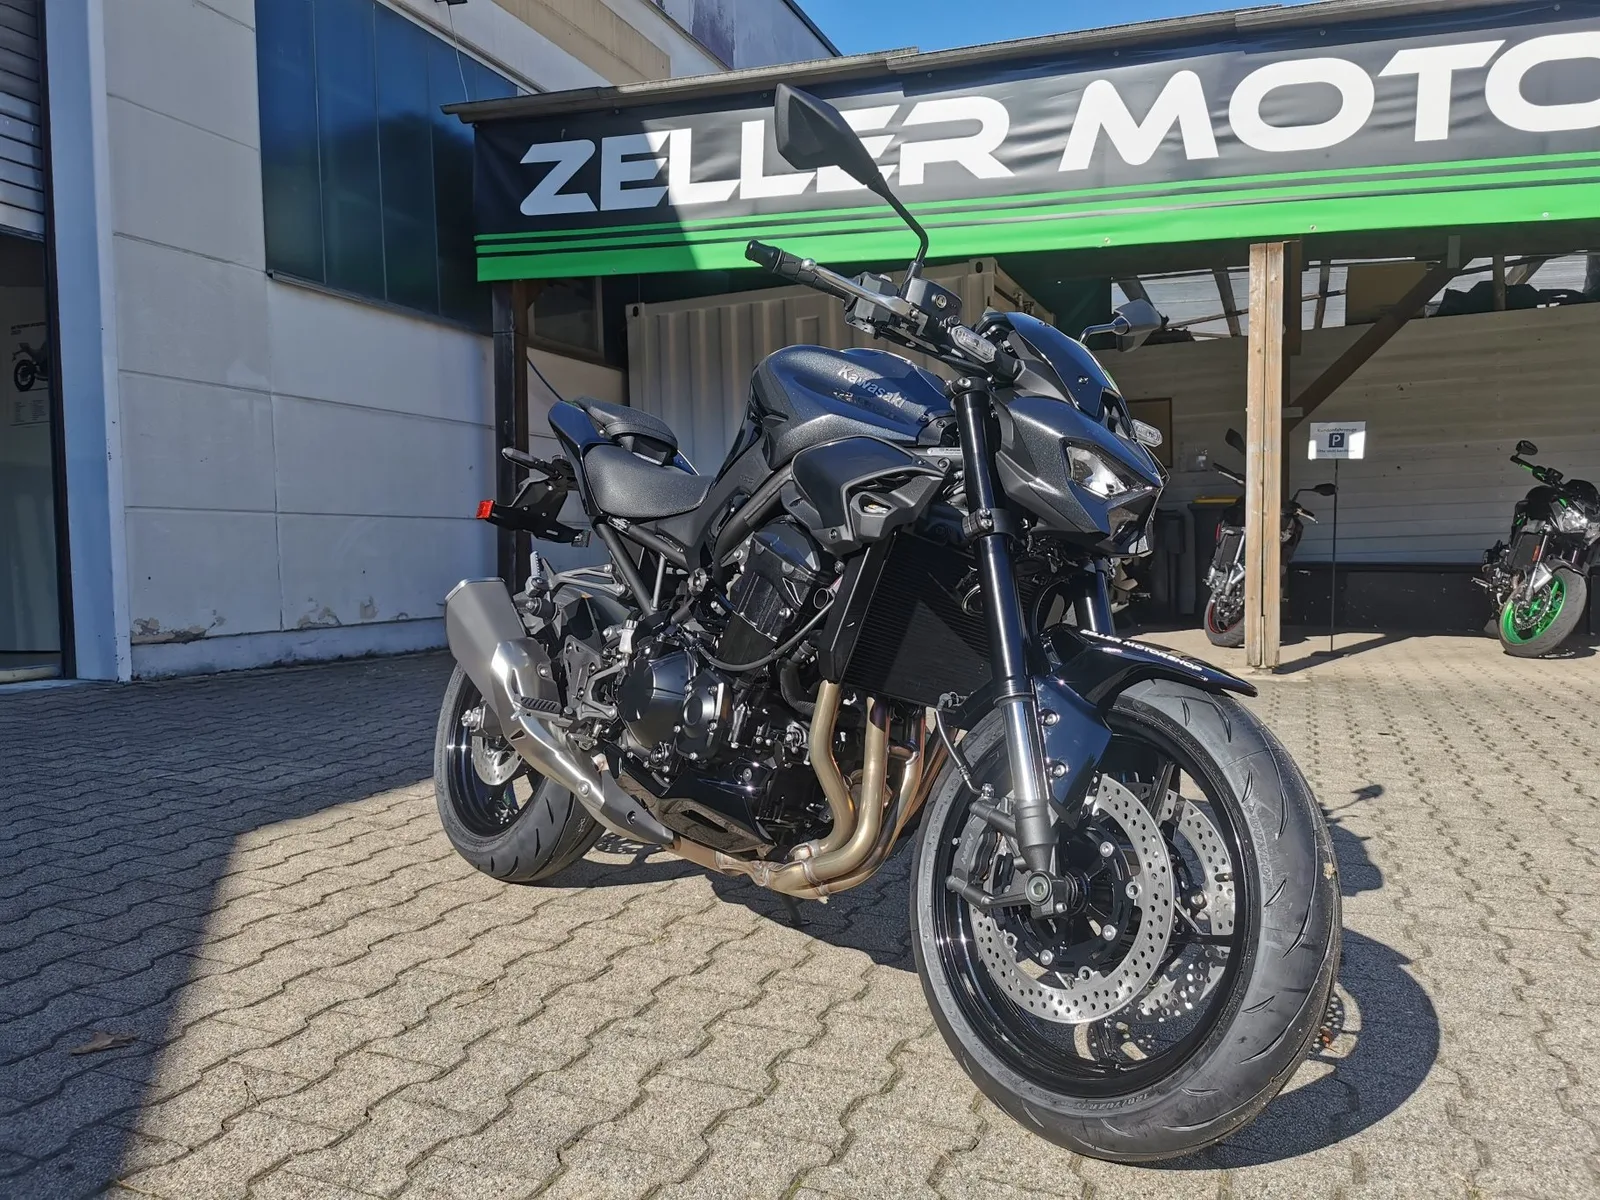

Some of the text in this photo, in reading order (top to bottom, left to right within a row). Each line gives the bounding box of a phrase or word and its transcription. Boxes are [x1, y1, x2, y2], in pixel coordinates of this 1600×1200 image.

[519, 31, 1600, 216] ZELLER MOTO
[837, 365, 908, 408] Kawasaki
[1333, 435, 1341, 446] P
[1122, 641, 1203, 671] MOTORSHOP
